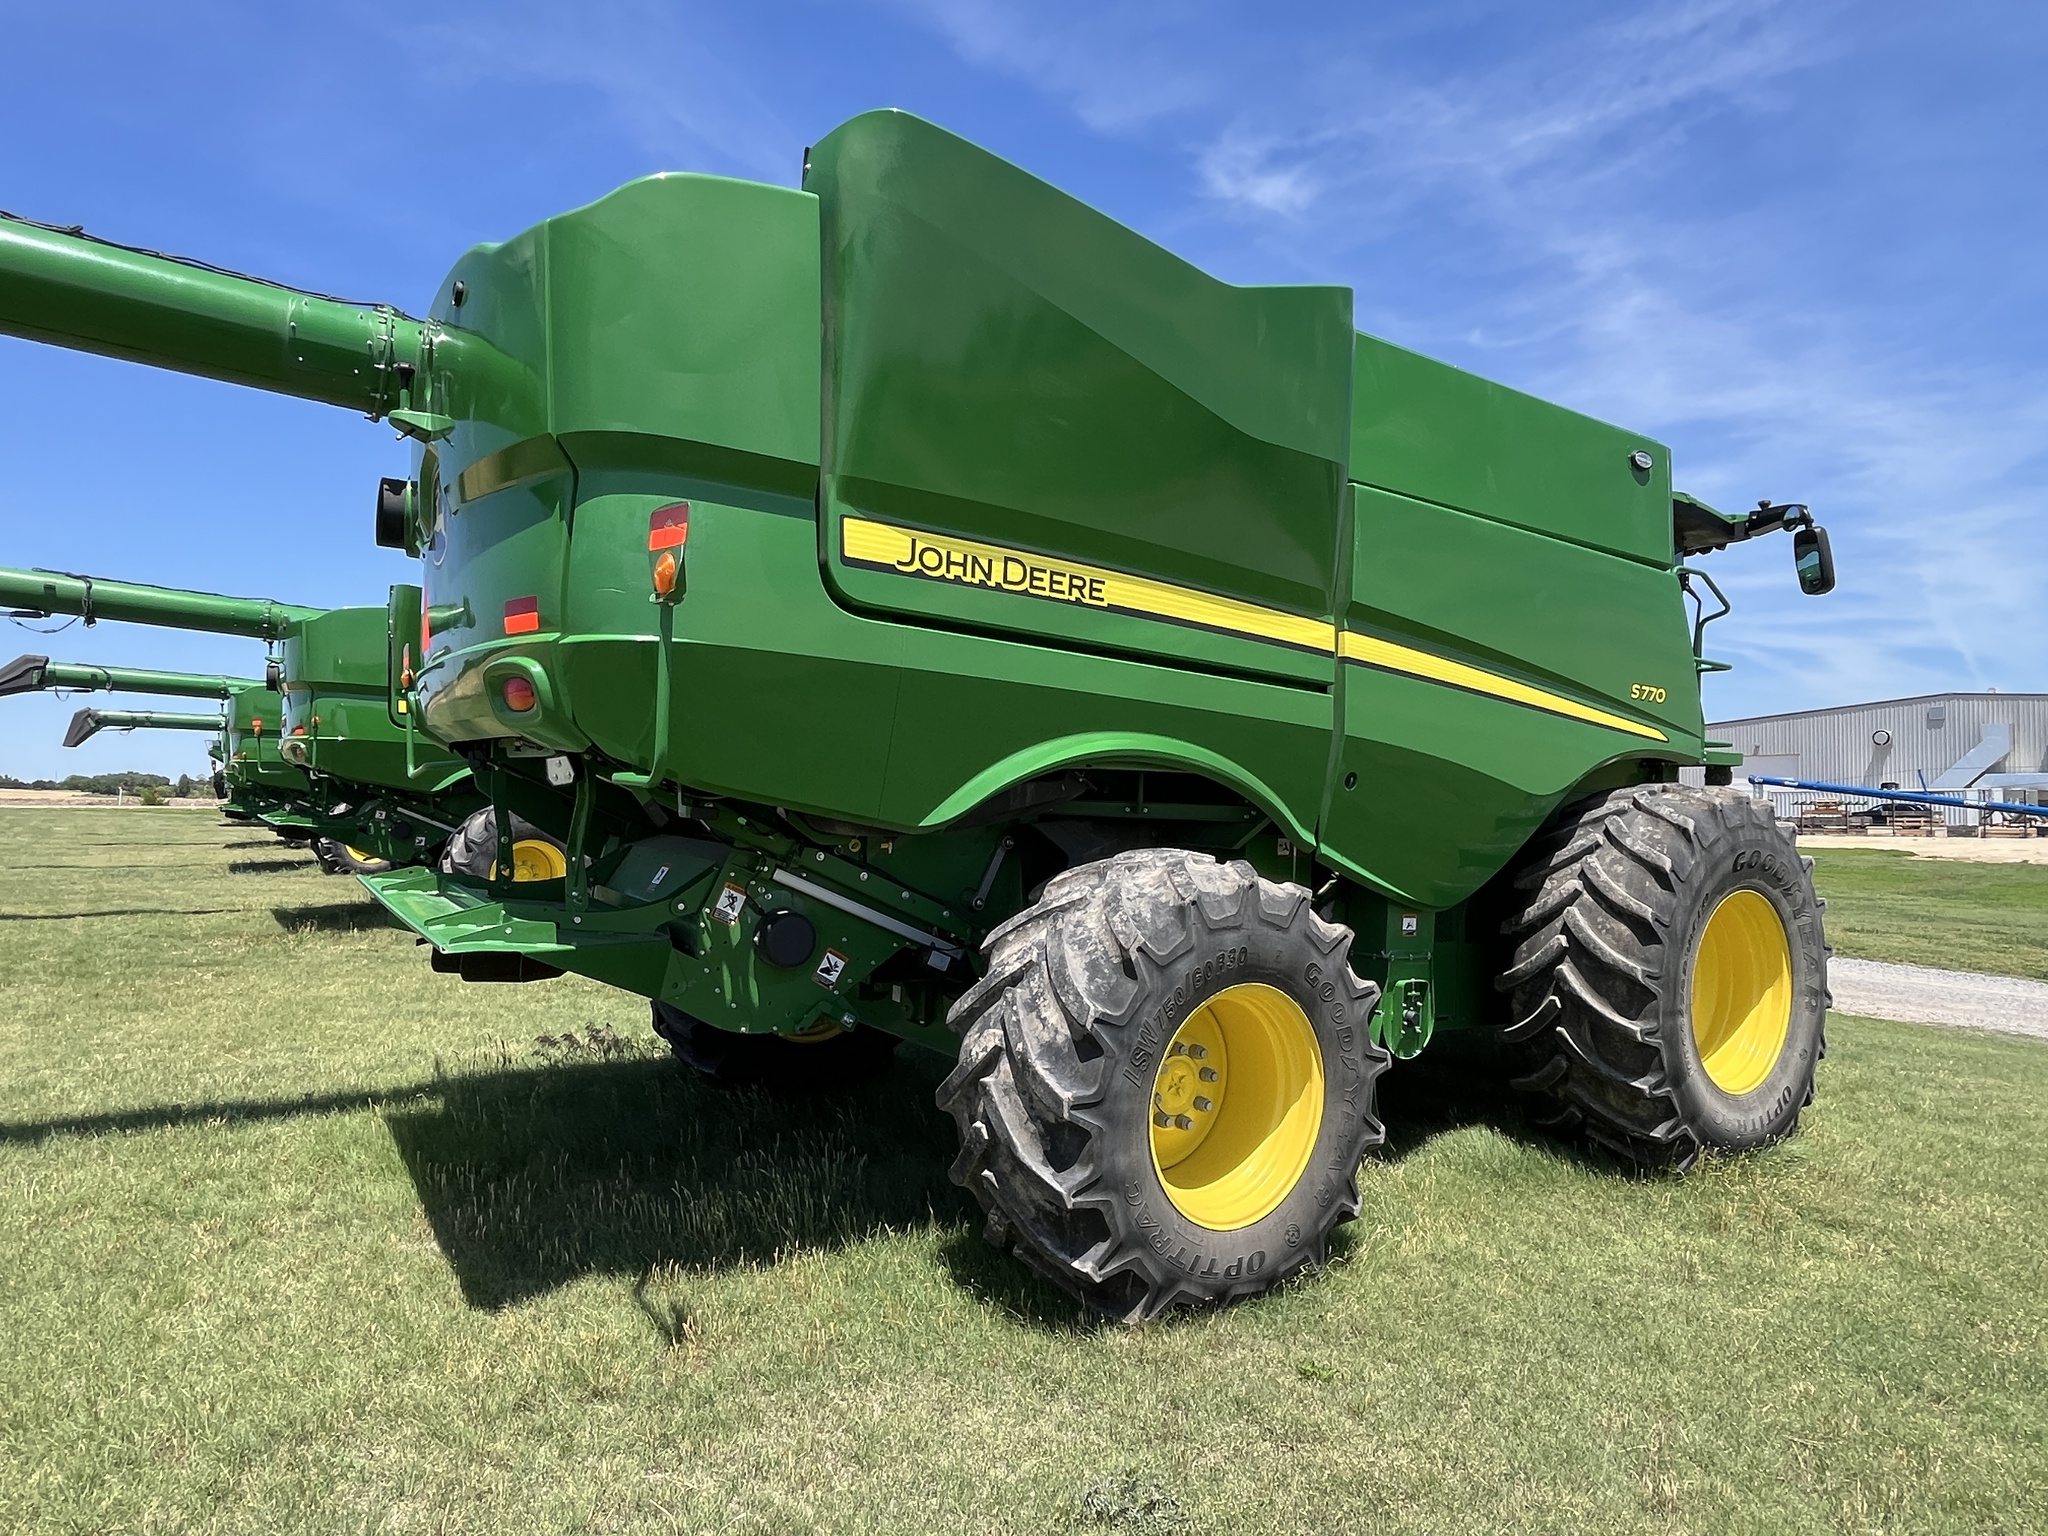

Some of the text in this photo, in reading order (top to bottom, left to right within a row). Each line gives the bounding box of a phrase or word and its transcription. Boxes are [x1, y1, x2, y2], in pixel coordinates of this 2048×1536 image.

[896, 537, 1106, 602] JOHN DEERE
[1630, 682, 1667, 704] S770
[1122, 1017, 1158, 1089] LSW
[1125, 1180, 1266, 1279] OPTITRAC
